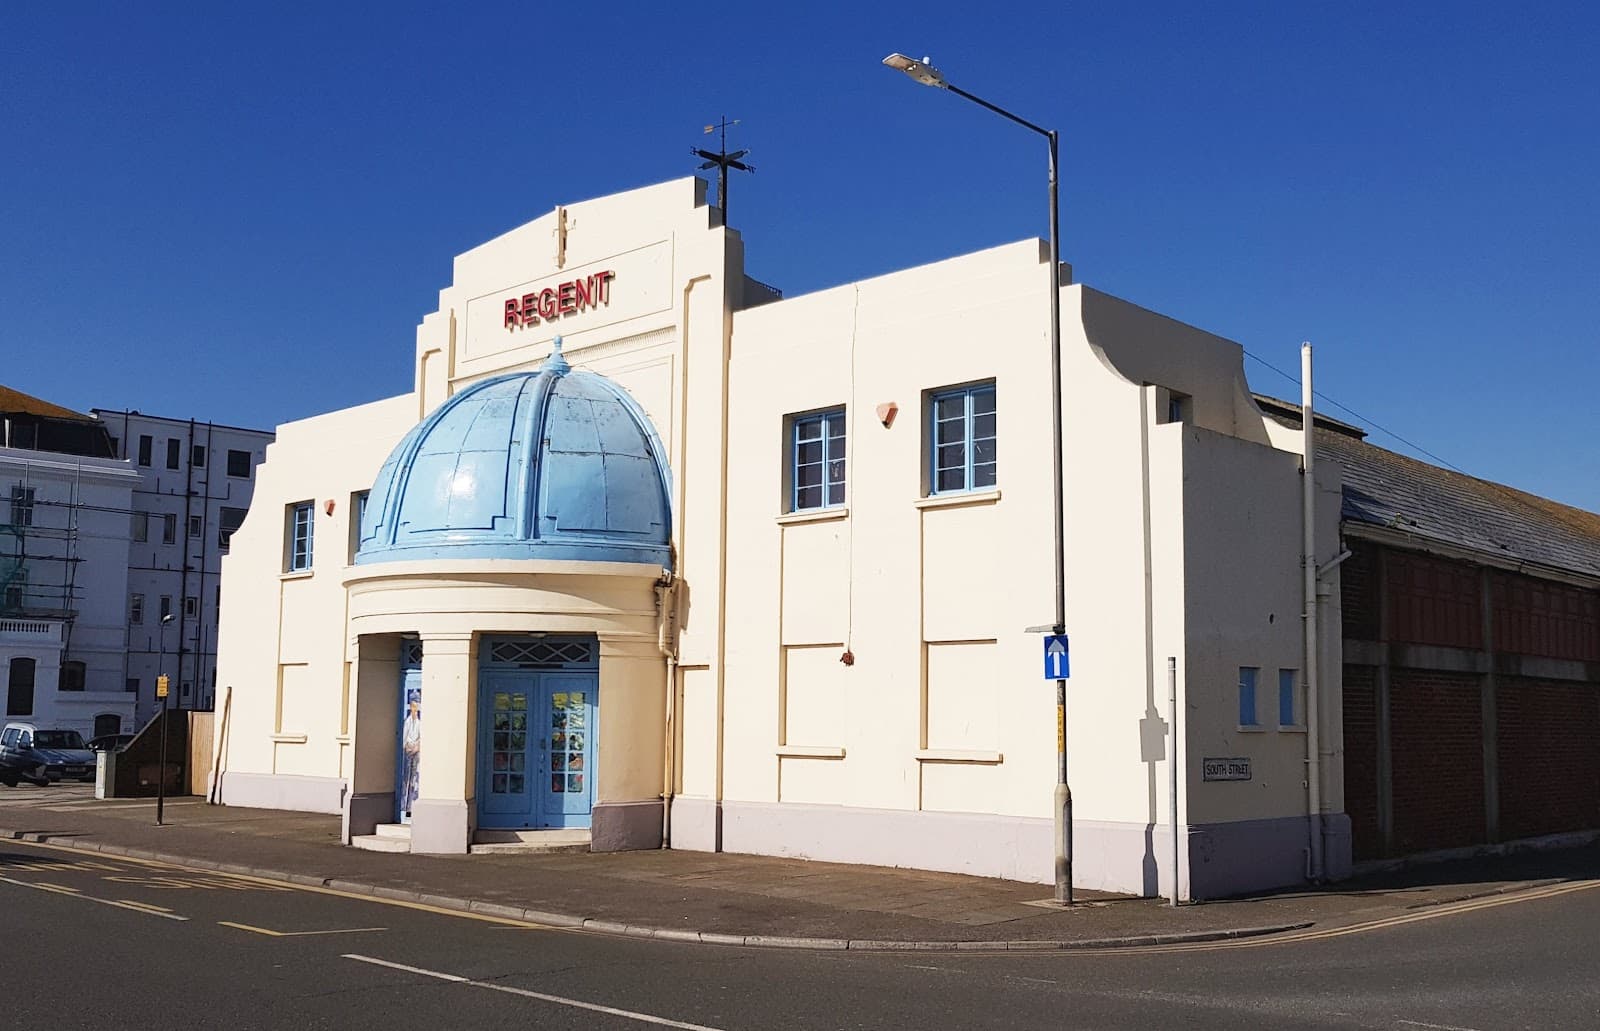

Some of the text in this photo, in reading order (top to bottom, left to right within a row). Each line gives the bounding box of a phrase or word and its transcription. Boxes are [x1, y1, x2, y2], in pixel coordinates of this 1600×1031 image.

[504, 270, 614, 330] REGENT
[1206, 763, 1249, 776] SOUTH STREET
